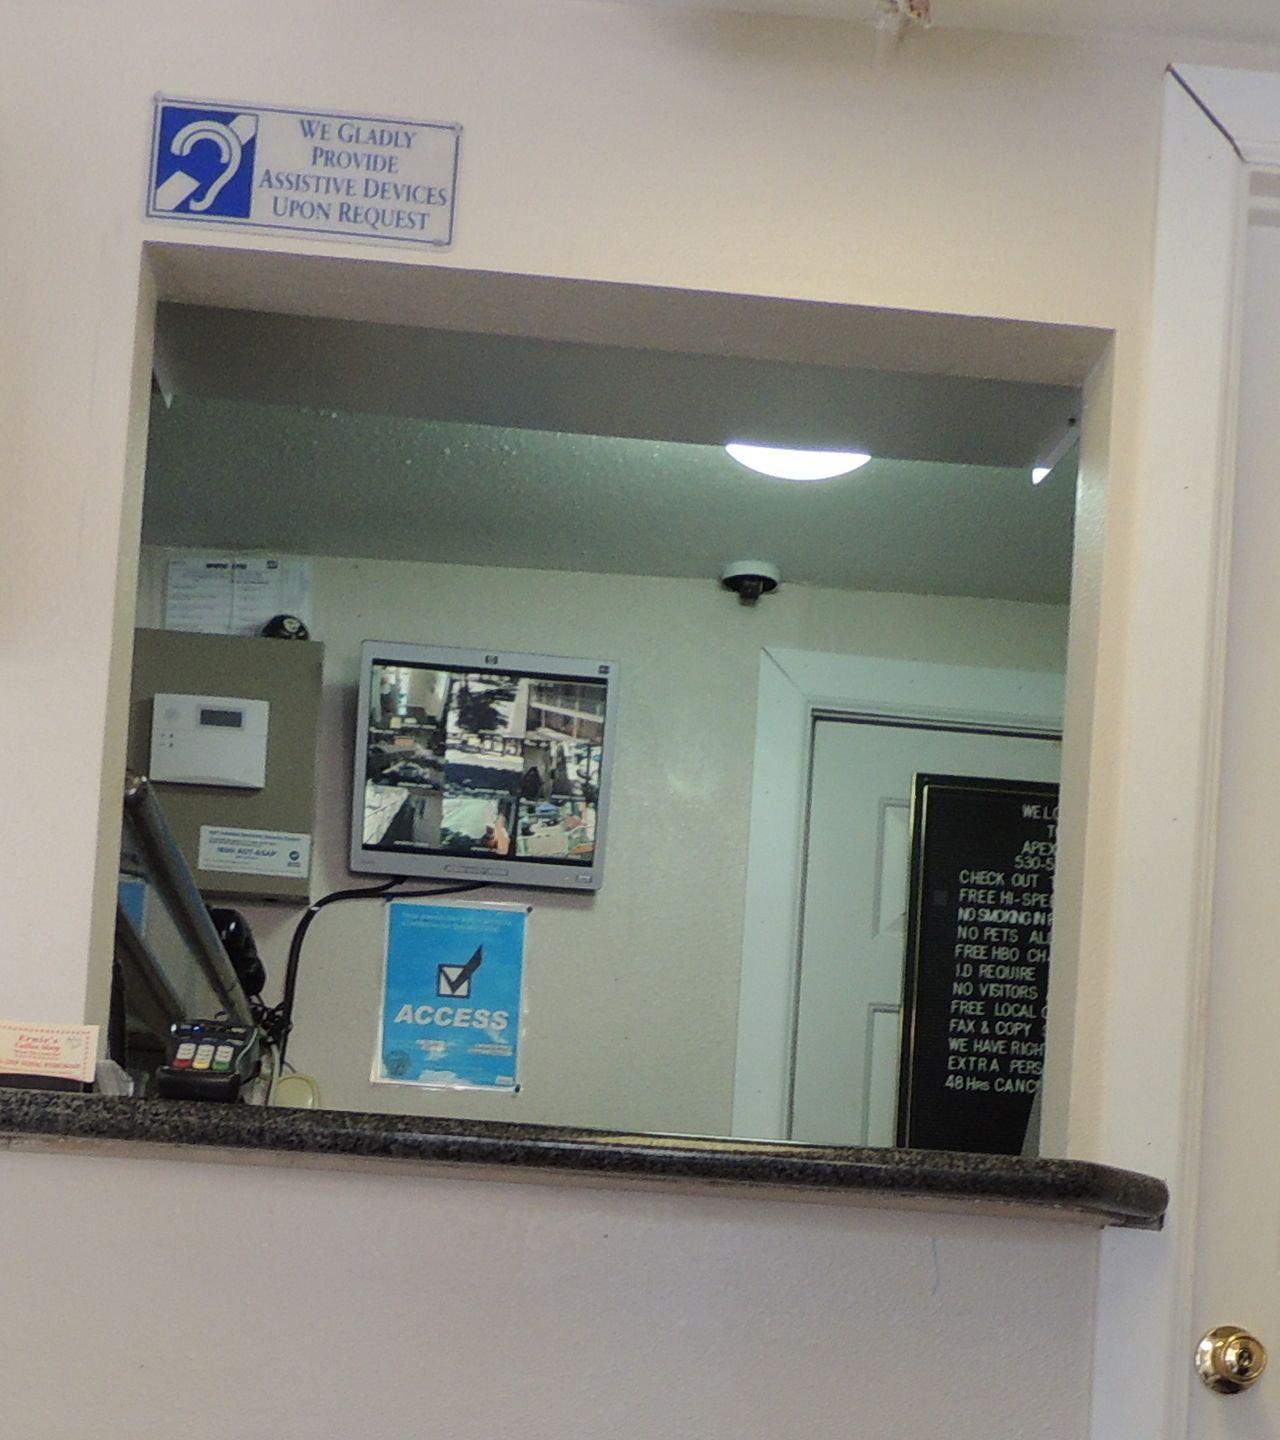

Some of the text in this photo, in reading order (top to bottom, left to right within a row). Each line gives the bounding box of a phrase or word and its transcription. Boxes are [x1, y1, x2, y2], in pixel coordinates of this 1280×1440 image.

[300, 118, 417, 149] WE GLADLY
[312, 147, 399, 173] PROVIDE
[259, 169, 448, 206] ASSISTIVE DEVICES
[273, 196, 430, 230] UPON REQUEST
[959, 869, 1005, 886] CHECK
[1011, 873, 1040, 888] OUT
[959, 888, 997, 904] FREE
[957, 907, 976, 921] NO
[977, 908, 1032, 926] SMOKING
[957, 925, 979, 940] NO
[983, 926, 1019, 943] PETS
[955, 944, 1051, 963] FREE HBO CH
[979, 964, 1036, 981] REQUIRE
[952, 981, 1038, 1000] NO VISITORS
[394, 1004, 509, 1030] ACCESS
[950, 1000, 985, 1016] FREE
[994, 1002, 1037, 1019] LOCAL
[949, 1019, 975, 1033] FAX
[981, 1020, 989, 1034] &
[995, 1021, 1032, 1037] COPY
[948, 1037, 969, 1052] WE
[973, 1039, 1008, 1055] HAVE
[948, 1056, 1000, 1072] EXTRA
